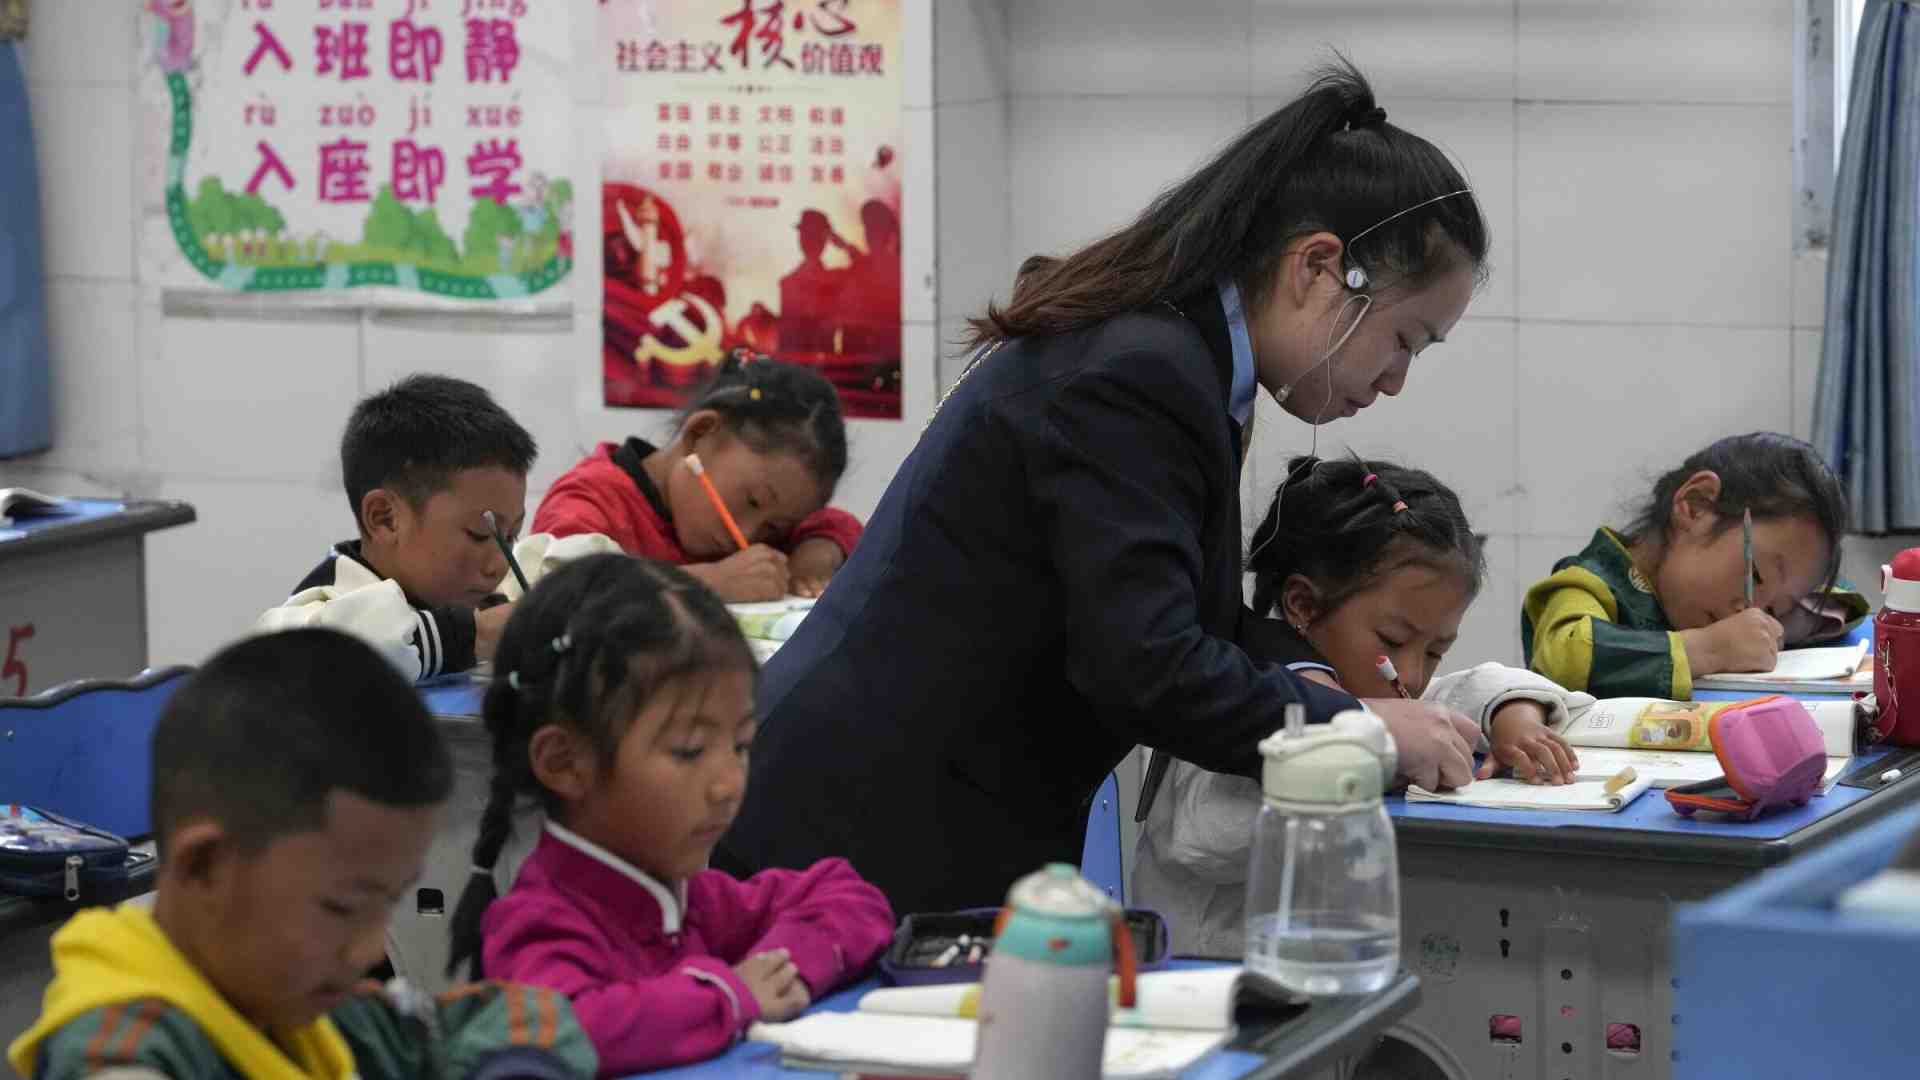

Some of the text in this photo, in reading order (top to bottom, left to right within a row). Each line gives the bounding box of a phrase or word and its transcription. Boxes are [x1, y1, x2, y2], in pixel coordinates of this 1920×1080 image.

[244, 18, 520, 83] 入班即静
[617, 0, 883, 75] 社会主义 核心 价值观
[245, 138, 522, 203] 入座即学
[2, 623, 34, 699] 5
